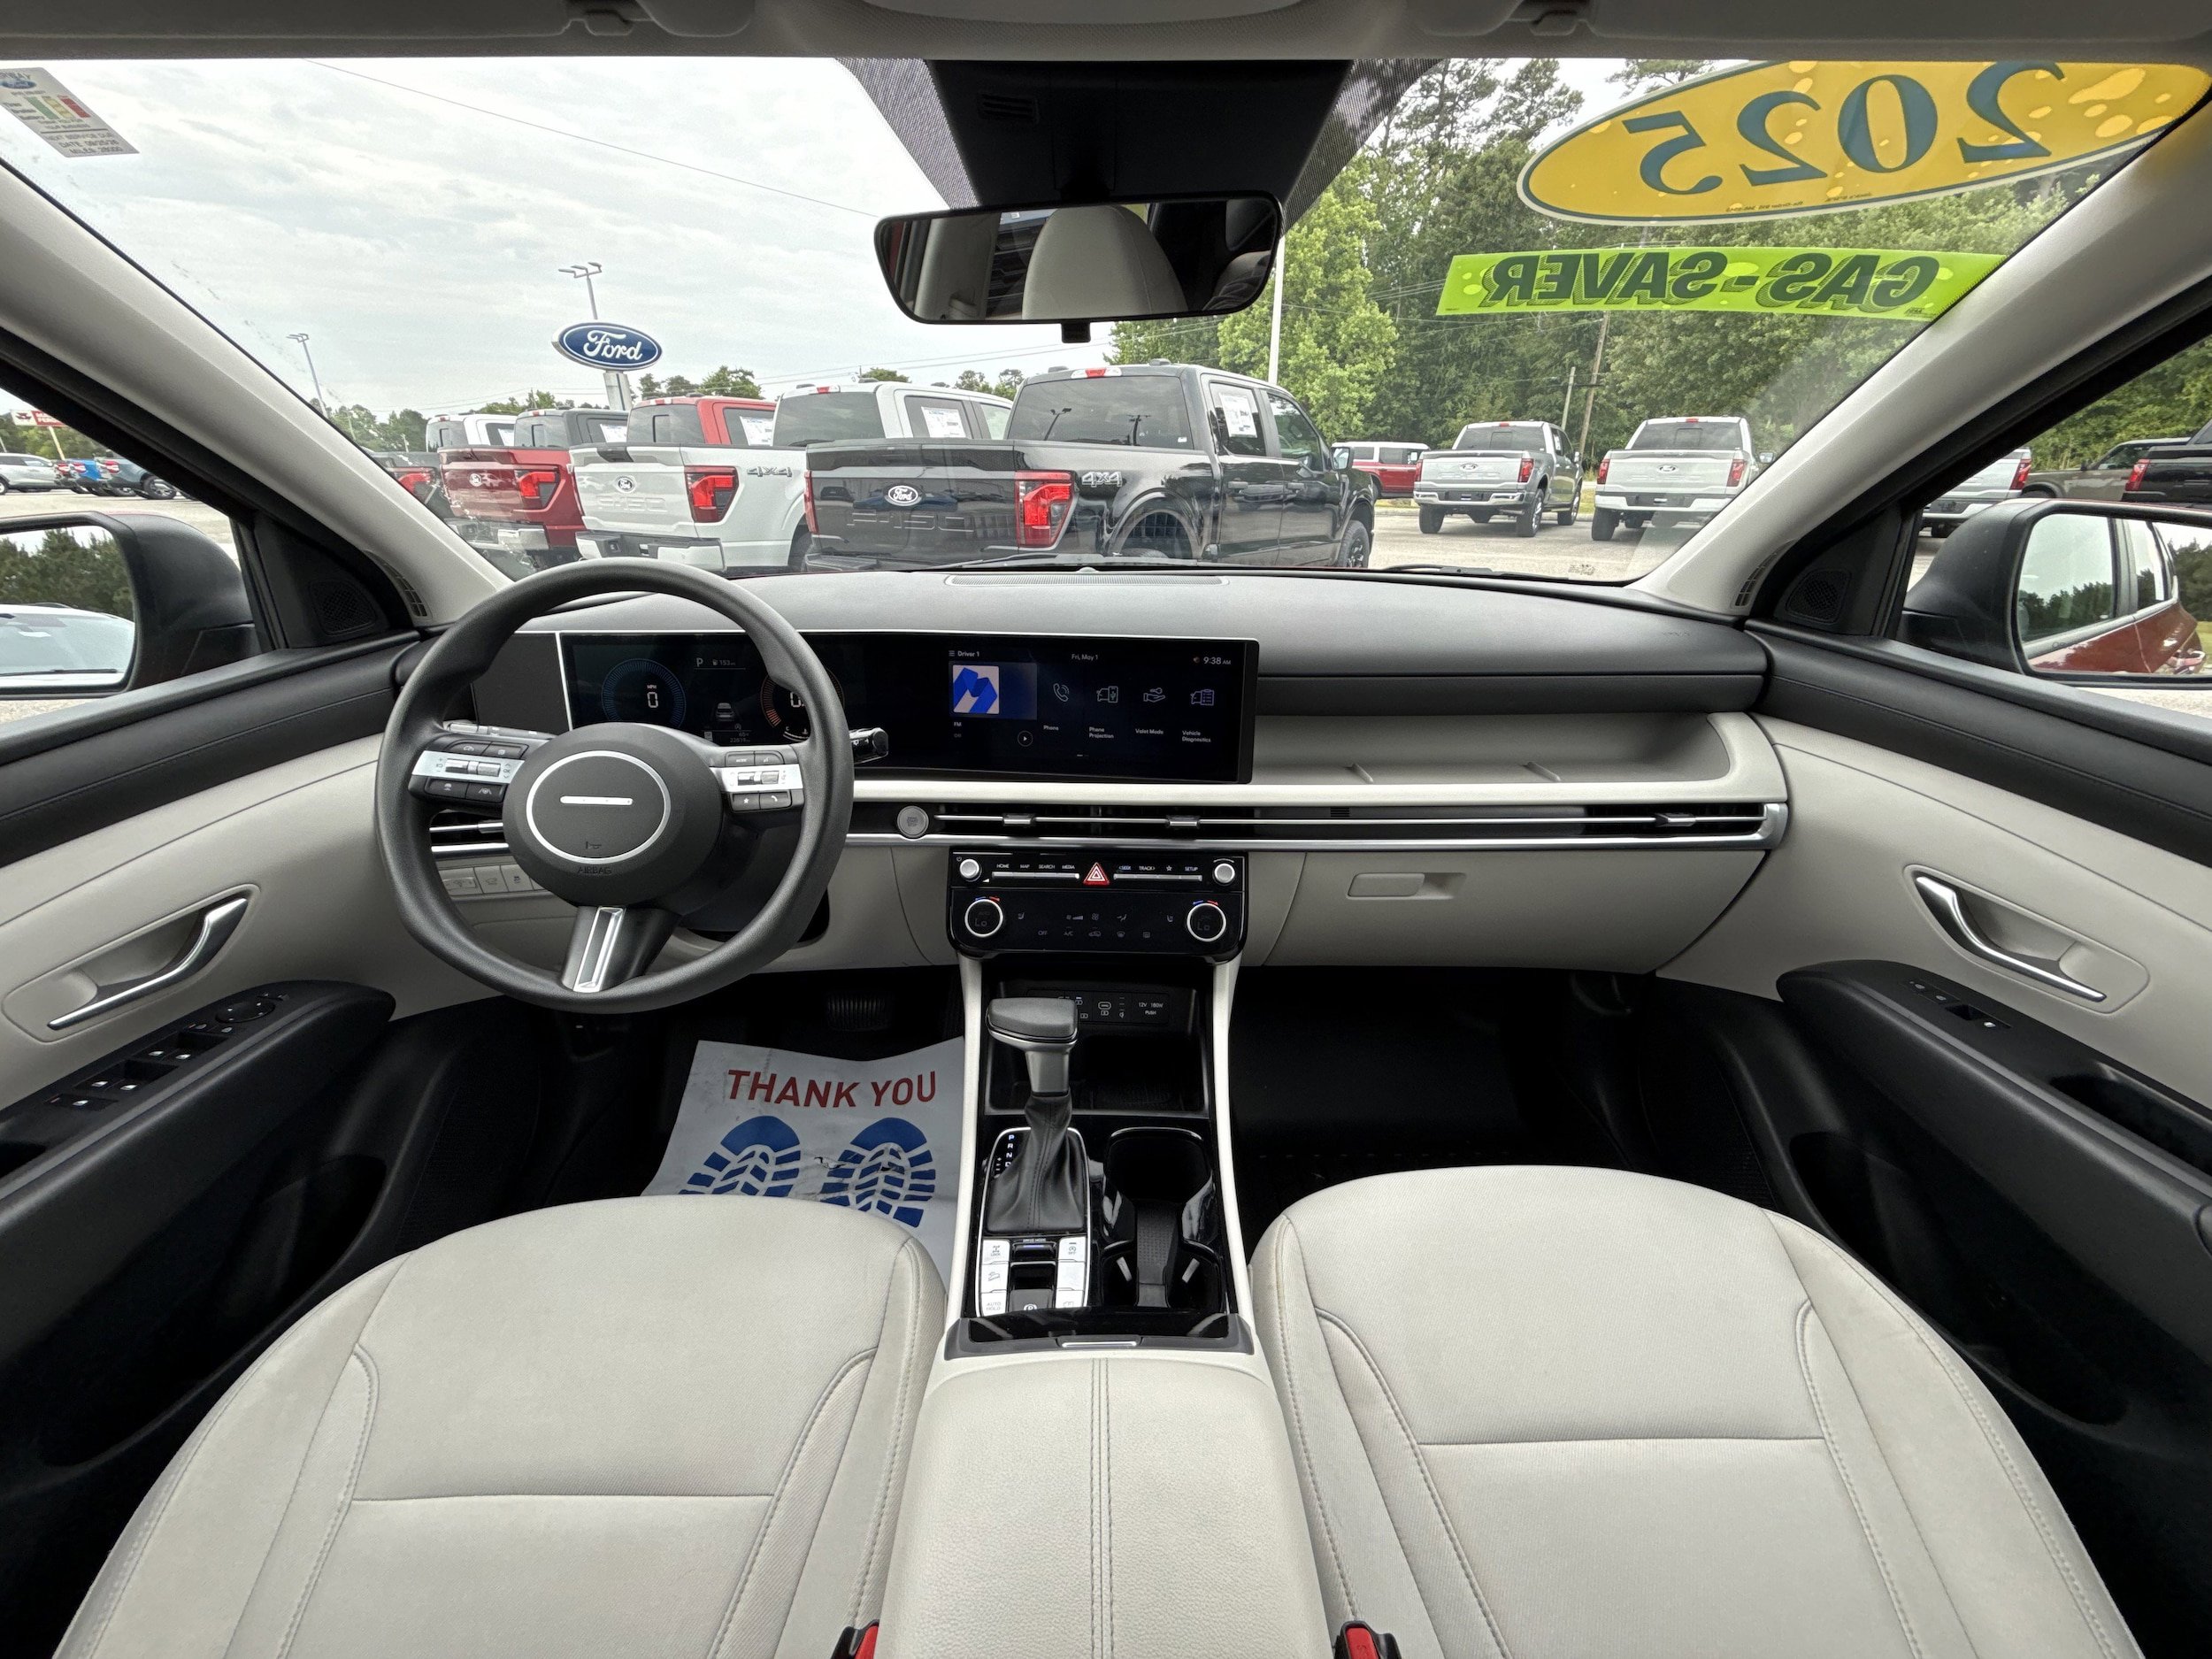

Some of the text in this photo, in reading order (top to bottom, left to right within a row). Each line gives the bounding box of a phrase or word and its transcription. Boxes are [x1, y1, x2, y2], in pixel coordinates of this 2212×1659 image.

[583, 329, 643, 360] Ford
[893, 488, 912, 502] Ford
[696, 657, 703, 667] P
[647, 691, 659, 709] 0
[577, 865, 613, 875] AIRBAG
[727, 1069, 936, 1108] THANK YOU
